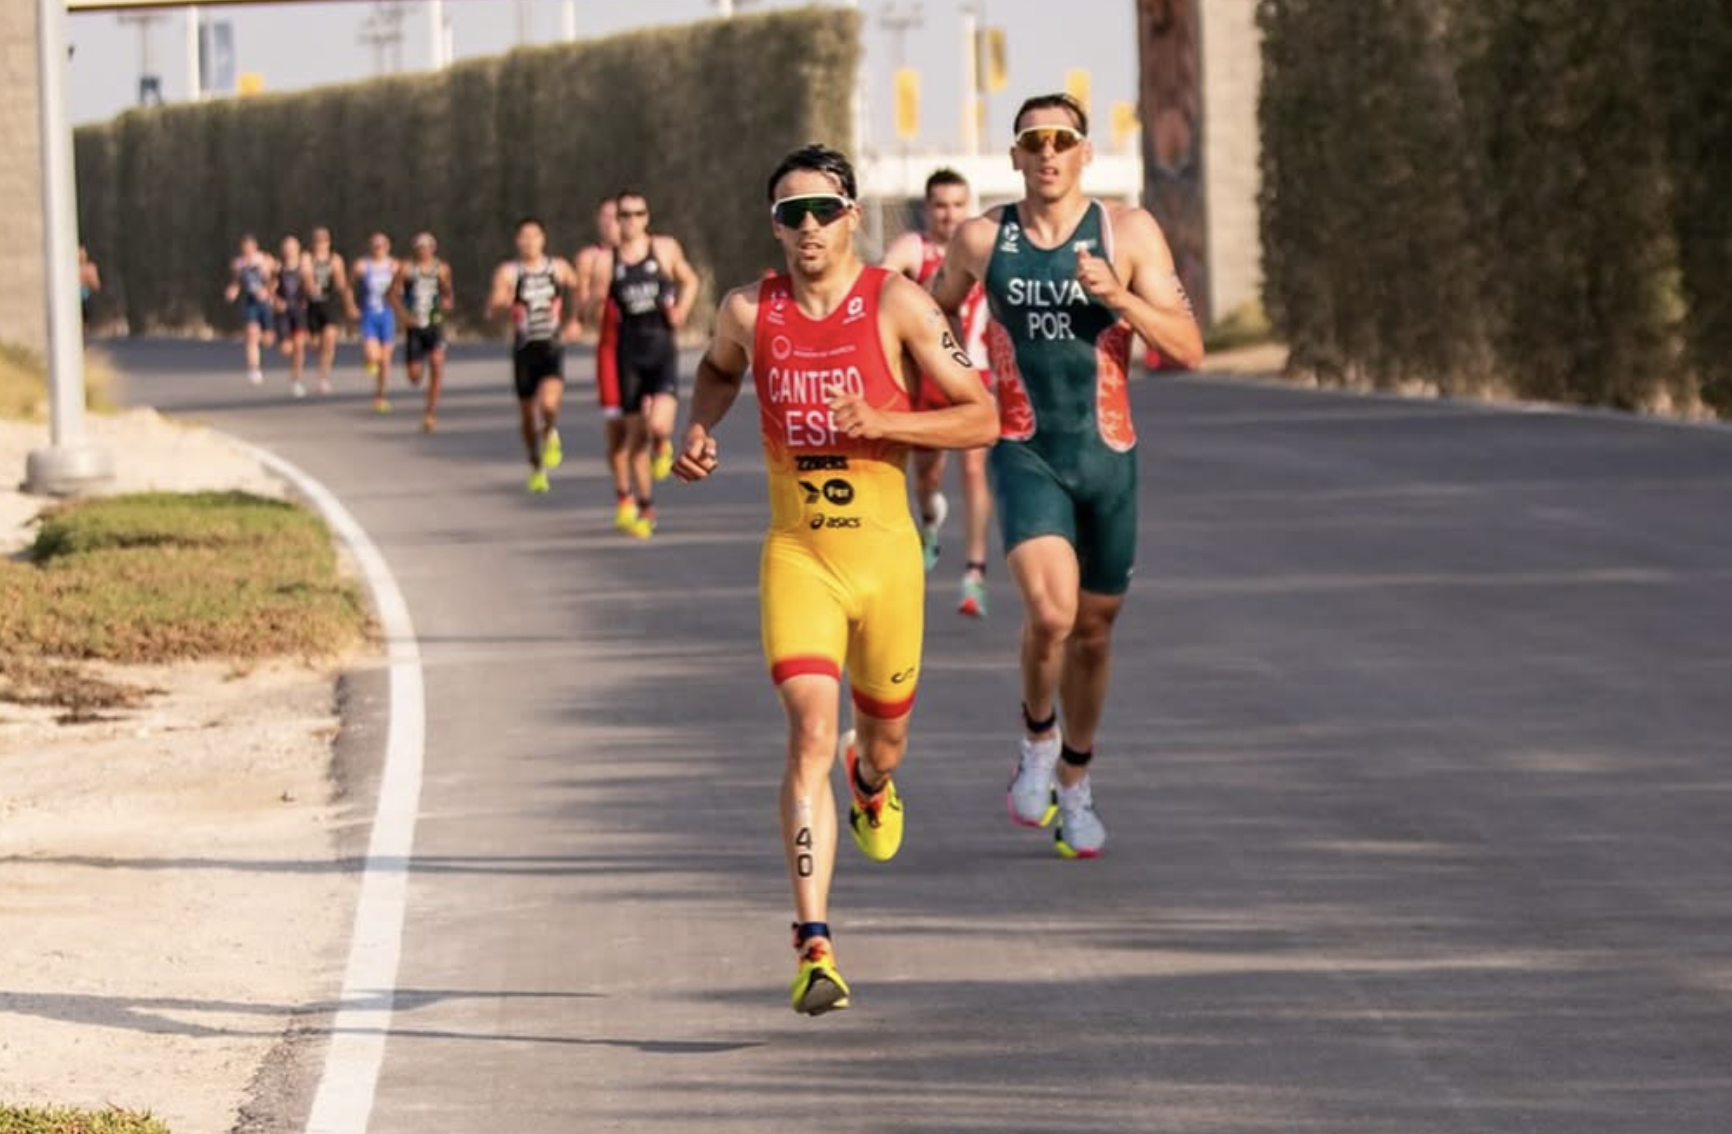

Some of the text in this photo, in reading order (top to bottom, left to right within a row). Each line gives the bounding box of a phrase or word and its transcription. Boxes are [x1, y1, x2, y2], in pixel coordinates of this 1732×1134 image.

[1007, 278, 1088, 306] SILVA
[1028, 312, 1076, 340] POR
[769, 366, 864, 404] CANTERO
[826, 517, 861, 528] asics
[796, 827, 813, 878] 40
